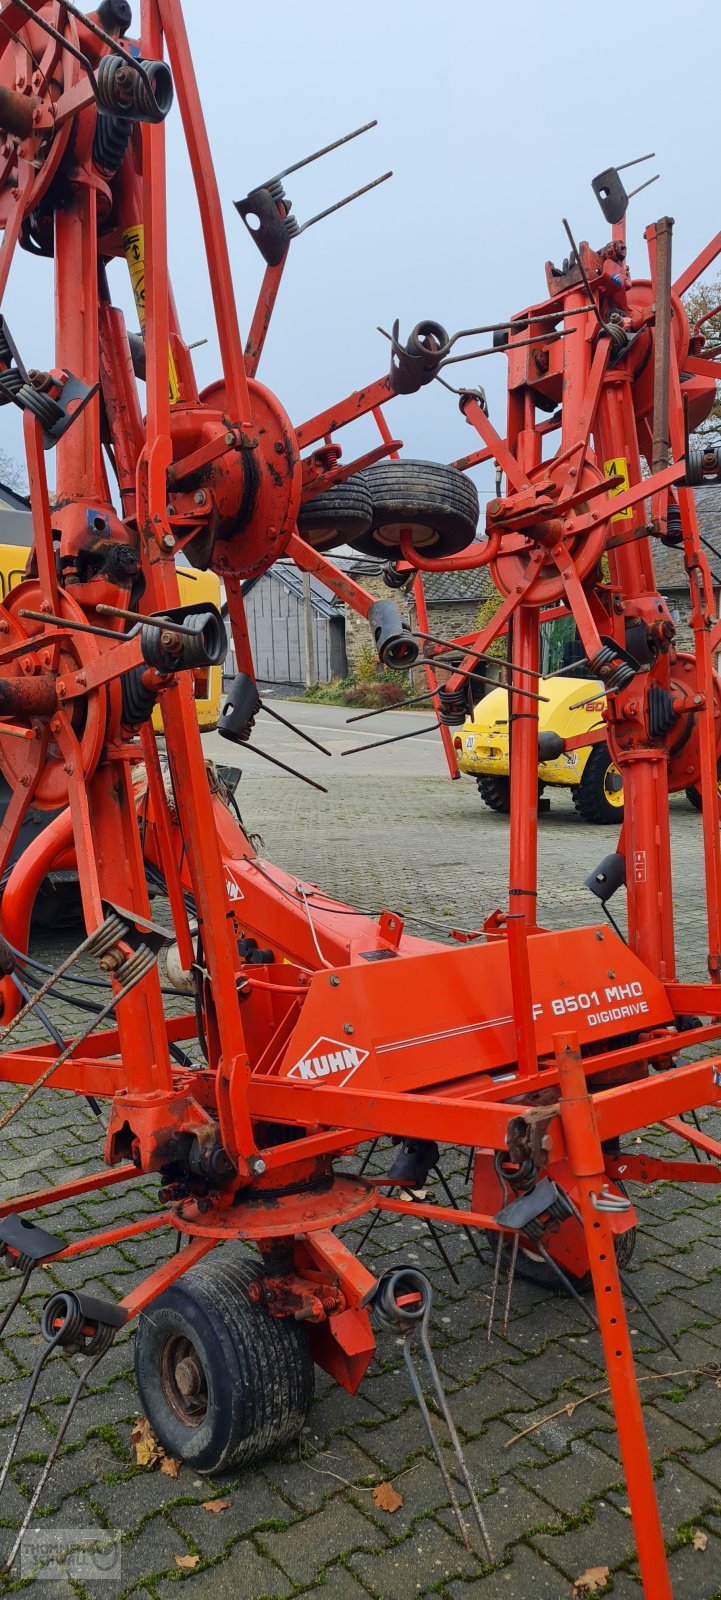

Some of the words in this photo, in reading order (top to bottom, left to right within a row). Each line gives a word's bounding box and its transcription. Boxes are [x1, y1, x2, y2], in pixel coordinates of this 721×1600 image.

[551, 990, 601, 1016] 8501
[587, 1001, 650, 1027] DIGIDRIVE
[297, 1047, 361, 1080] KUHN
